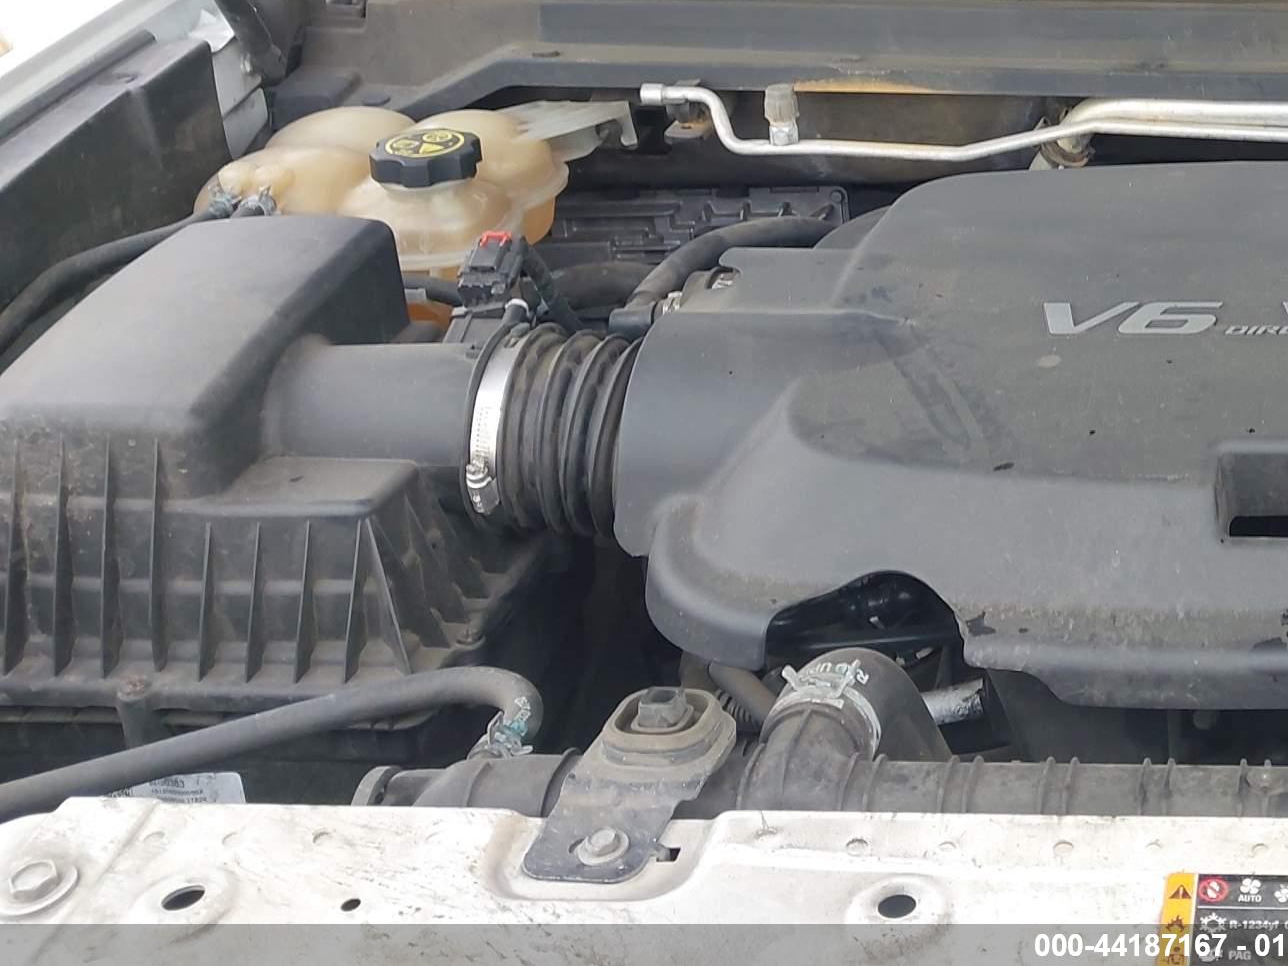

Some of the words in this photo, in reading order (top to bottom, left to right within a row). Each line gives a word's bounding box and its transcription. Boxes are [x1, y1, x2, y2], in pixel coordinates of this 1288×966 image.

[1043, 300, 1223, 335] V6
[1238, 894, 1262, 903] AUTO
[1228, 950, 1251, 960] PAG
